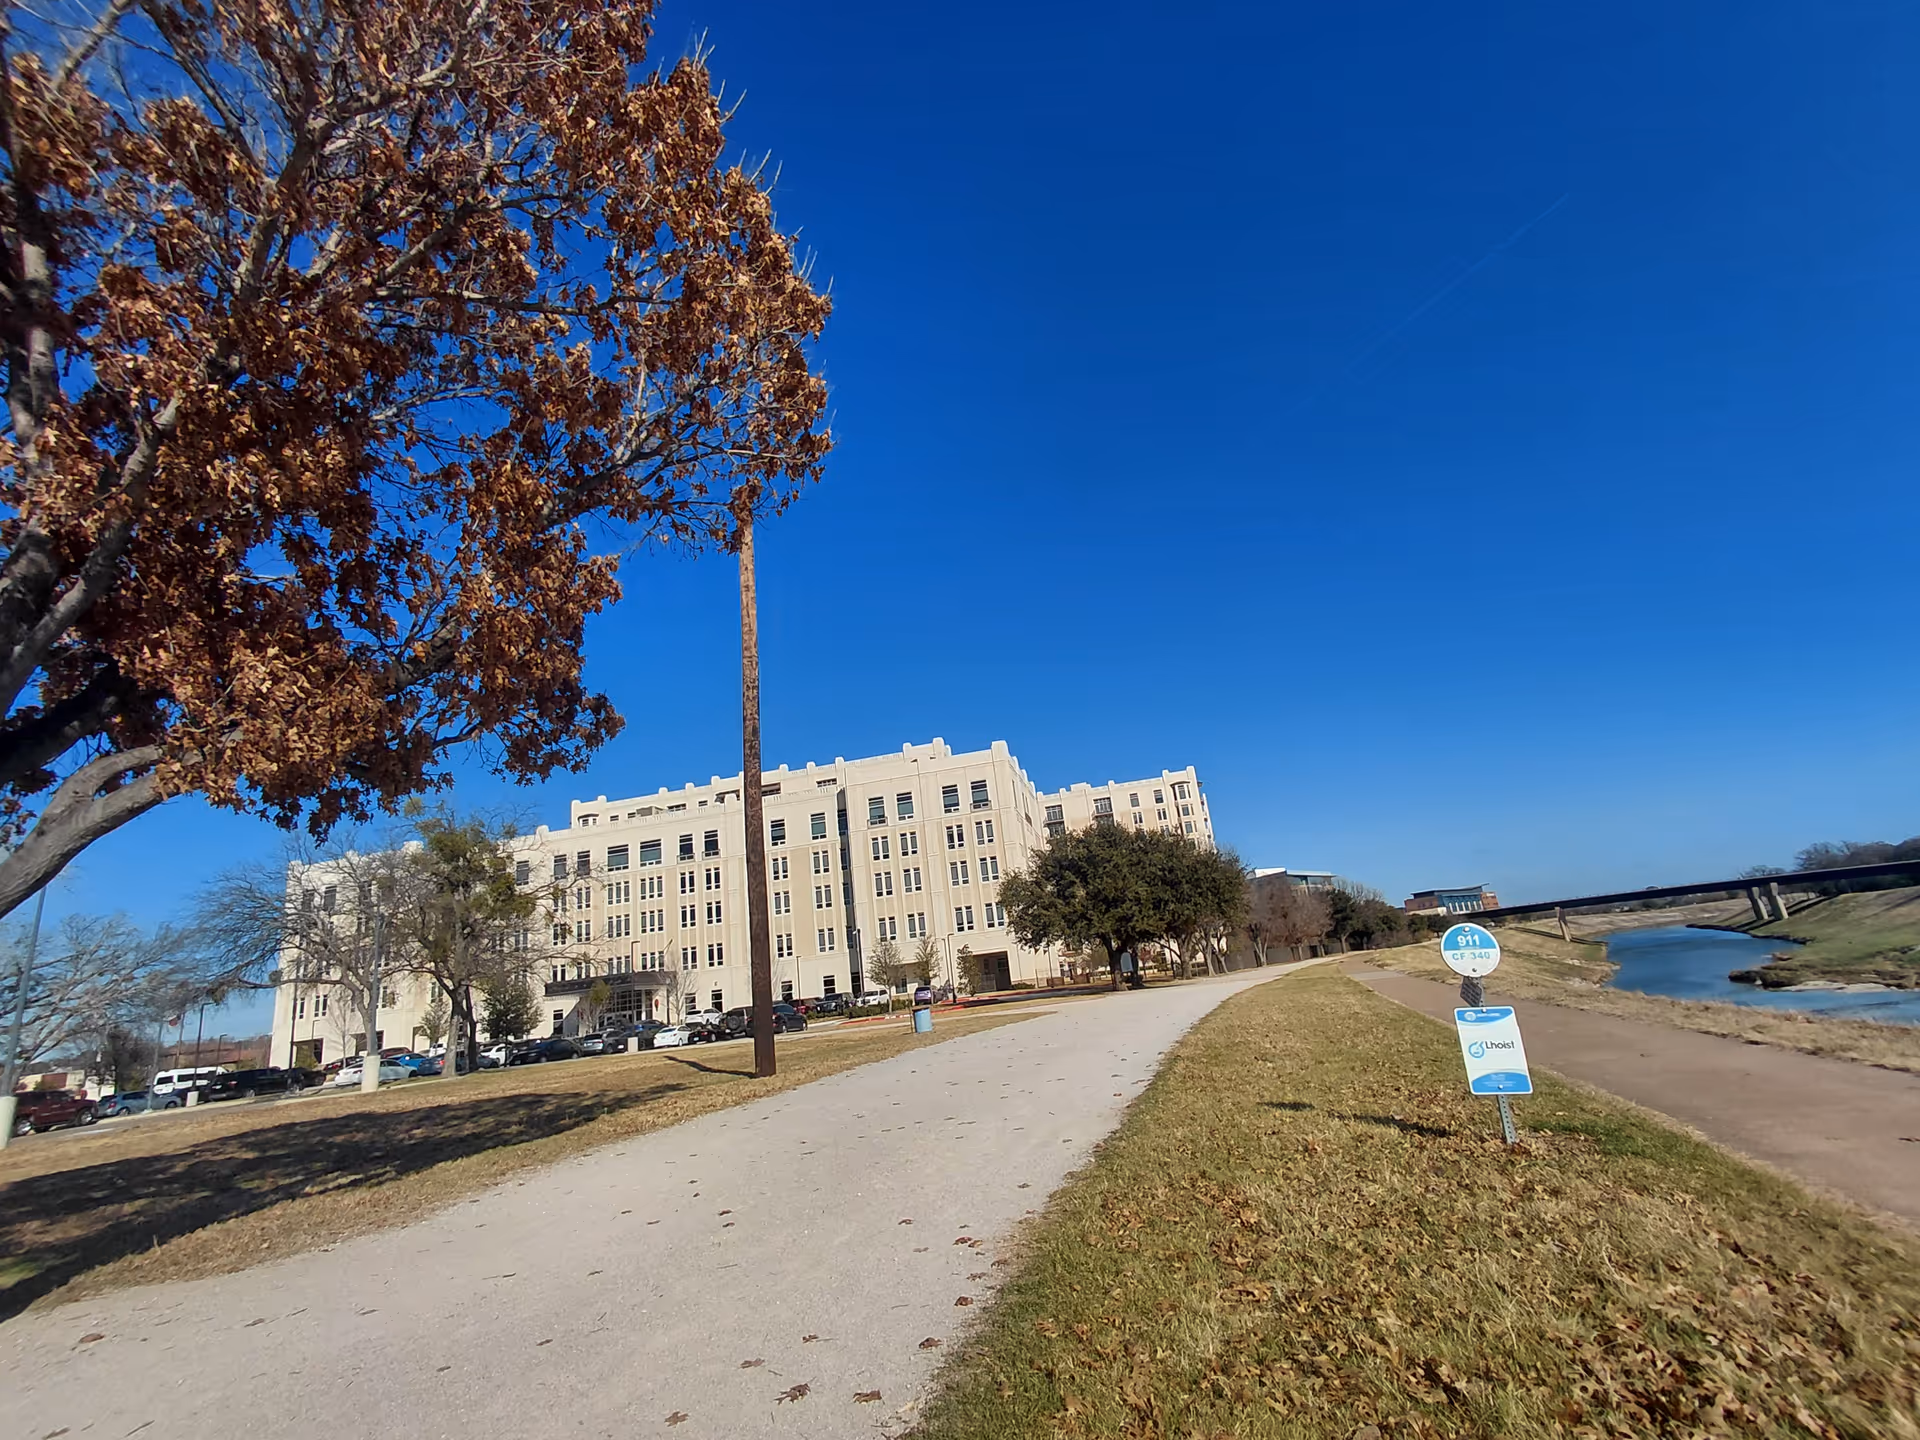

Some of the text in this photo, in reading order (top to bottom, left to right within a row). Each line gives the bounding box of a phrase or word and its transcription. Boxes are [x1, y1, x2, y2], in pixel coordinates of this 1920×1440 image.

[1457, 934, 1480, 946] 911
[1452, 951, 1490, 960] CF 340
[1485, 1040, 1515, 1049] Lhoist
